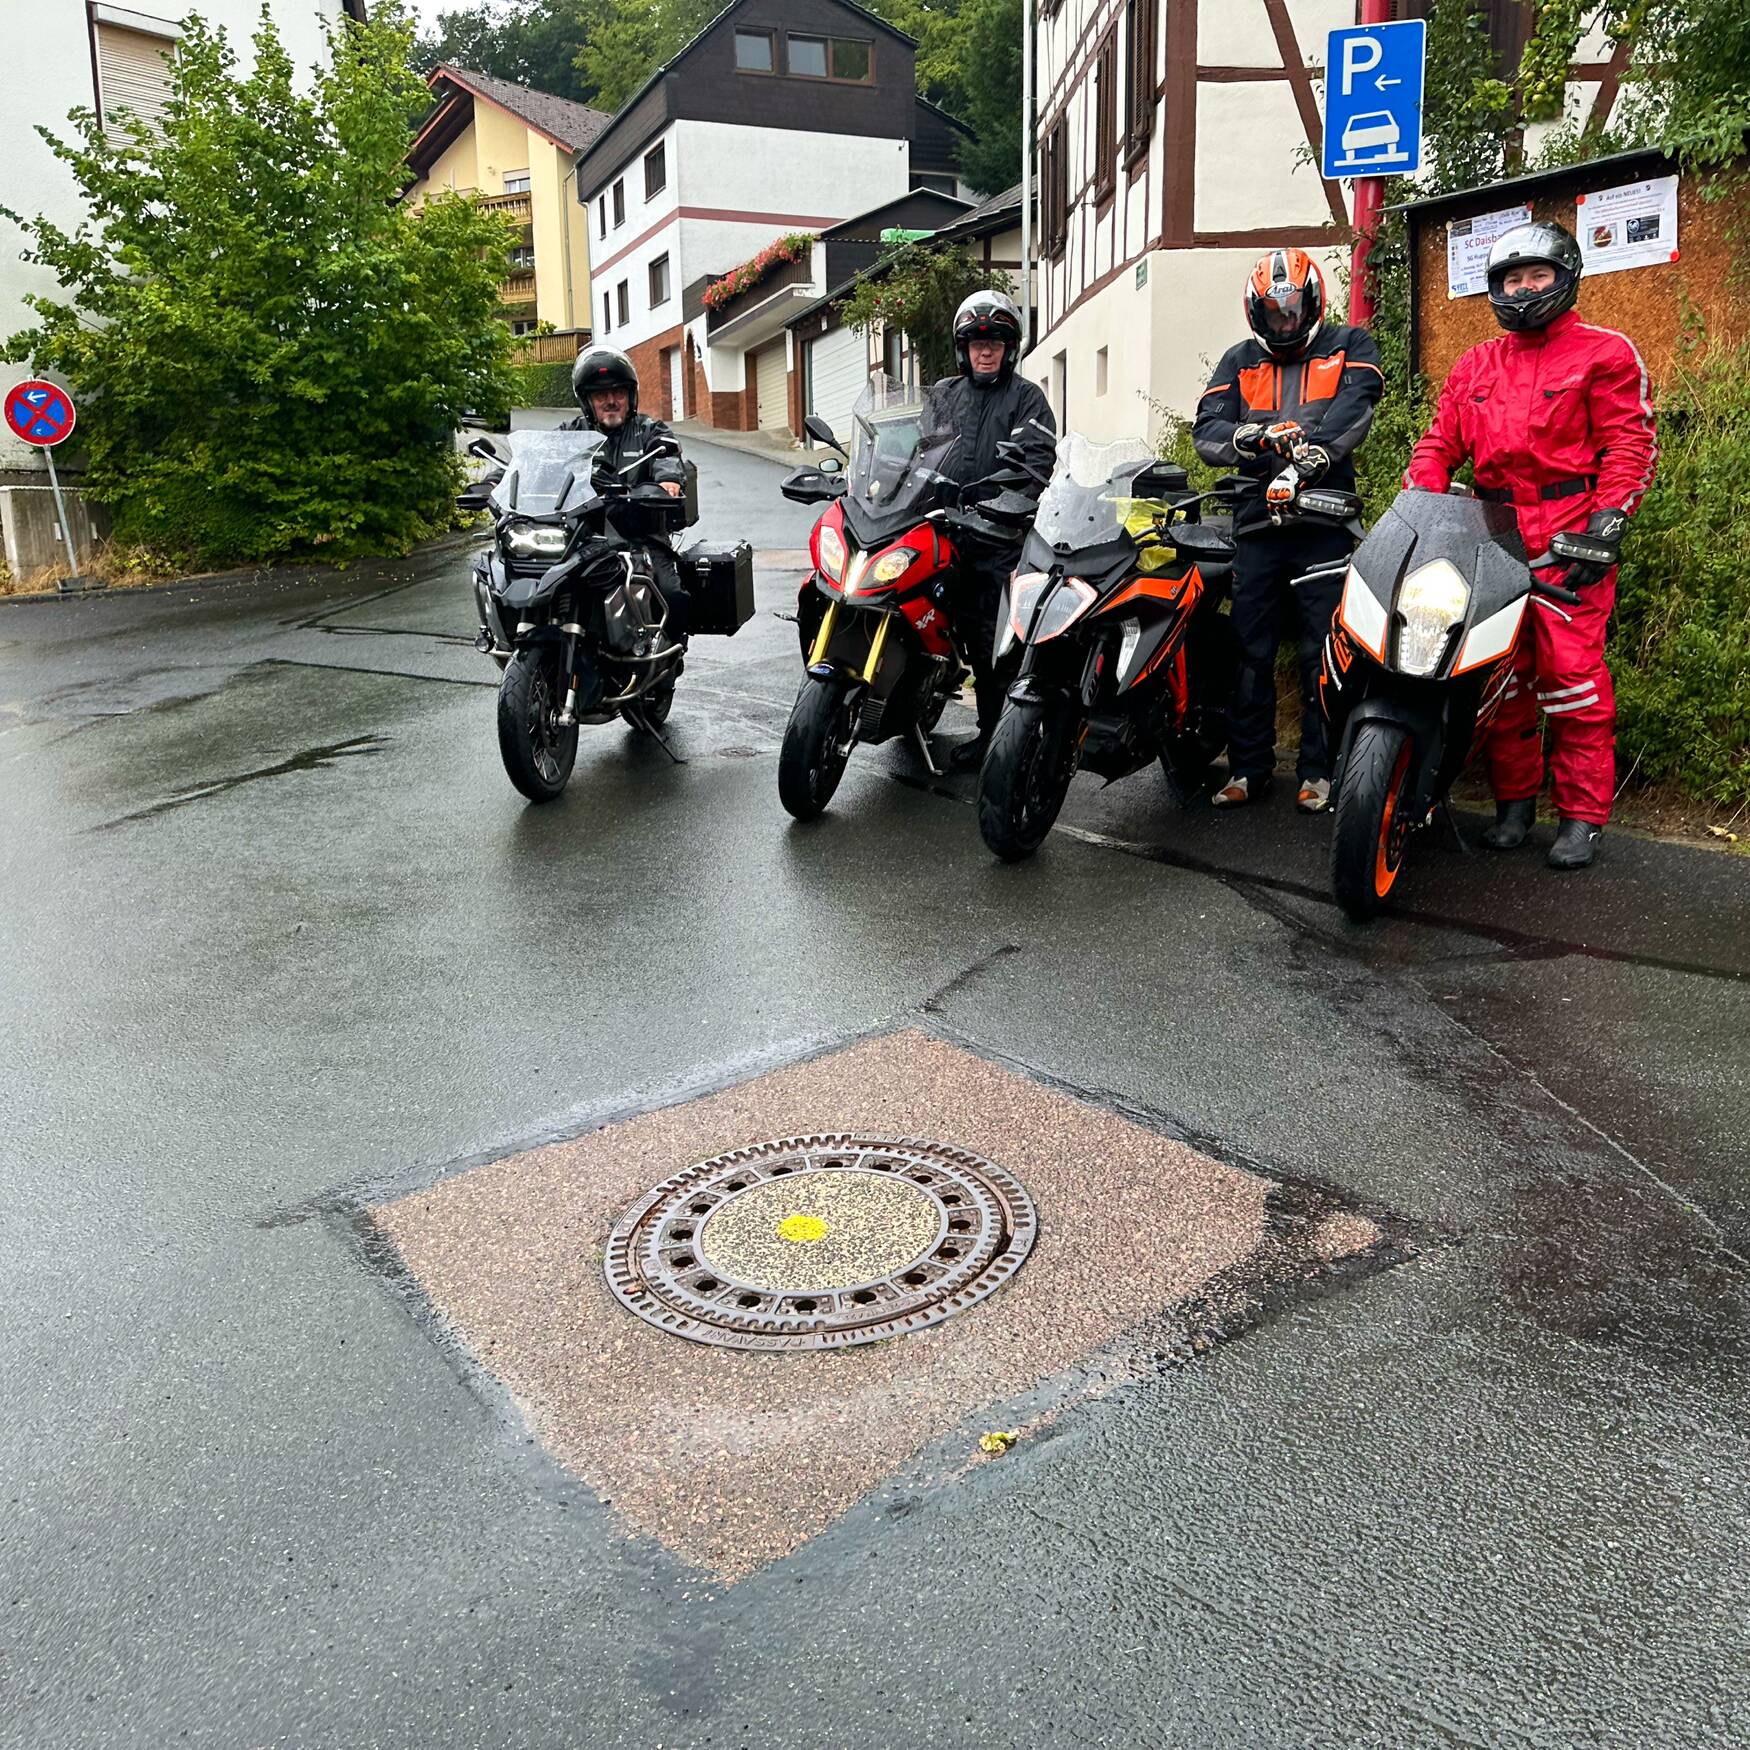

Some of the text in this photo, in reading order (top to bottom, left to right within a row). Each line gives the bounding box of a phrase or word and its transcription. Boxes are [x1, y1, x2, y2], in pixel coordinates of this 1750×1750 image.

[1342, 36, 1383, 96] P
[1464, 232, 1502, 249] SC Daisba
[1269, 284, 1293, 295] Arai
